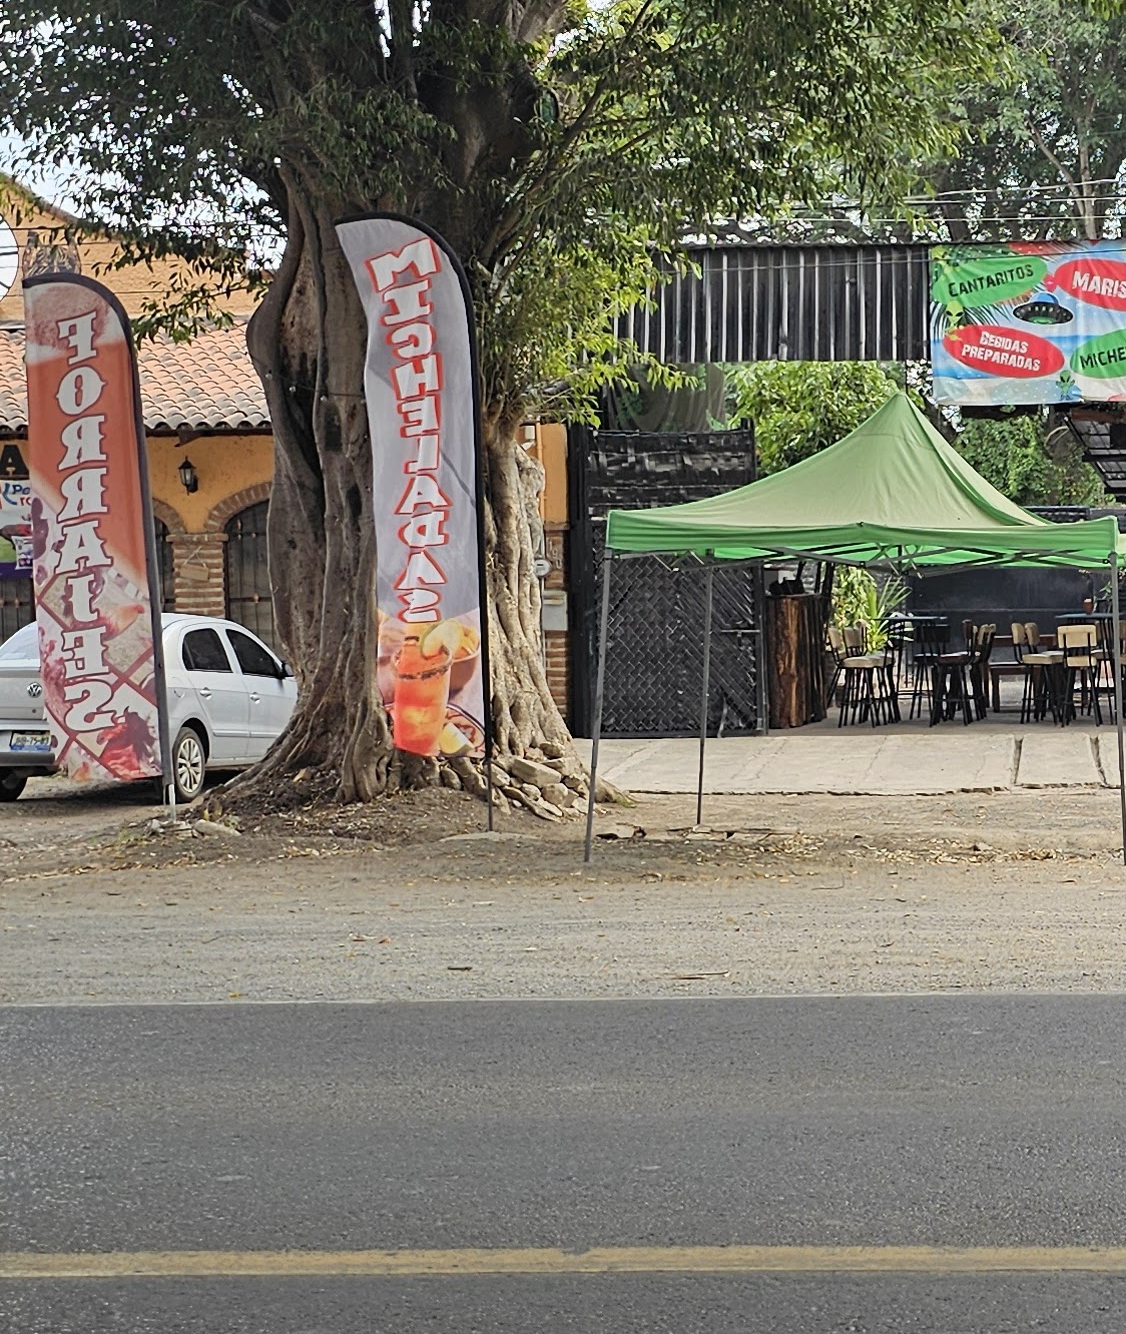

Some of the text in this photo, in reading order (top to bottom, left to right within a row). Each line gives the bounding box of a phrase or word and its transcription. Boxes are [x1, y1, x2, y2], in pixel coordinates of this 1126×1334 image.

[948, 264, 1034, 297] CANTARITOS
[980, 331, 1029, 353] BEBIDAS
[961, 344, 1041, 371] PREPARADAS
